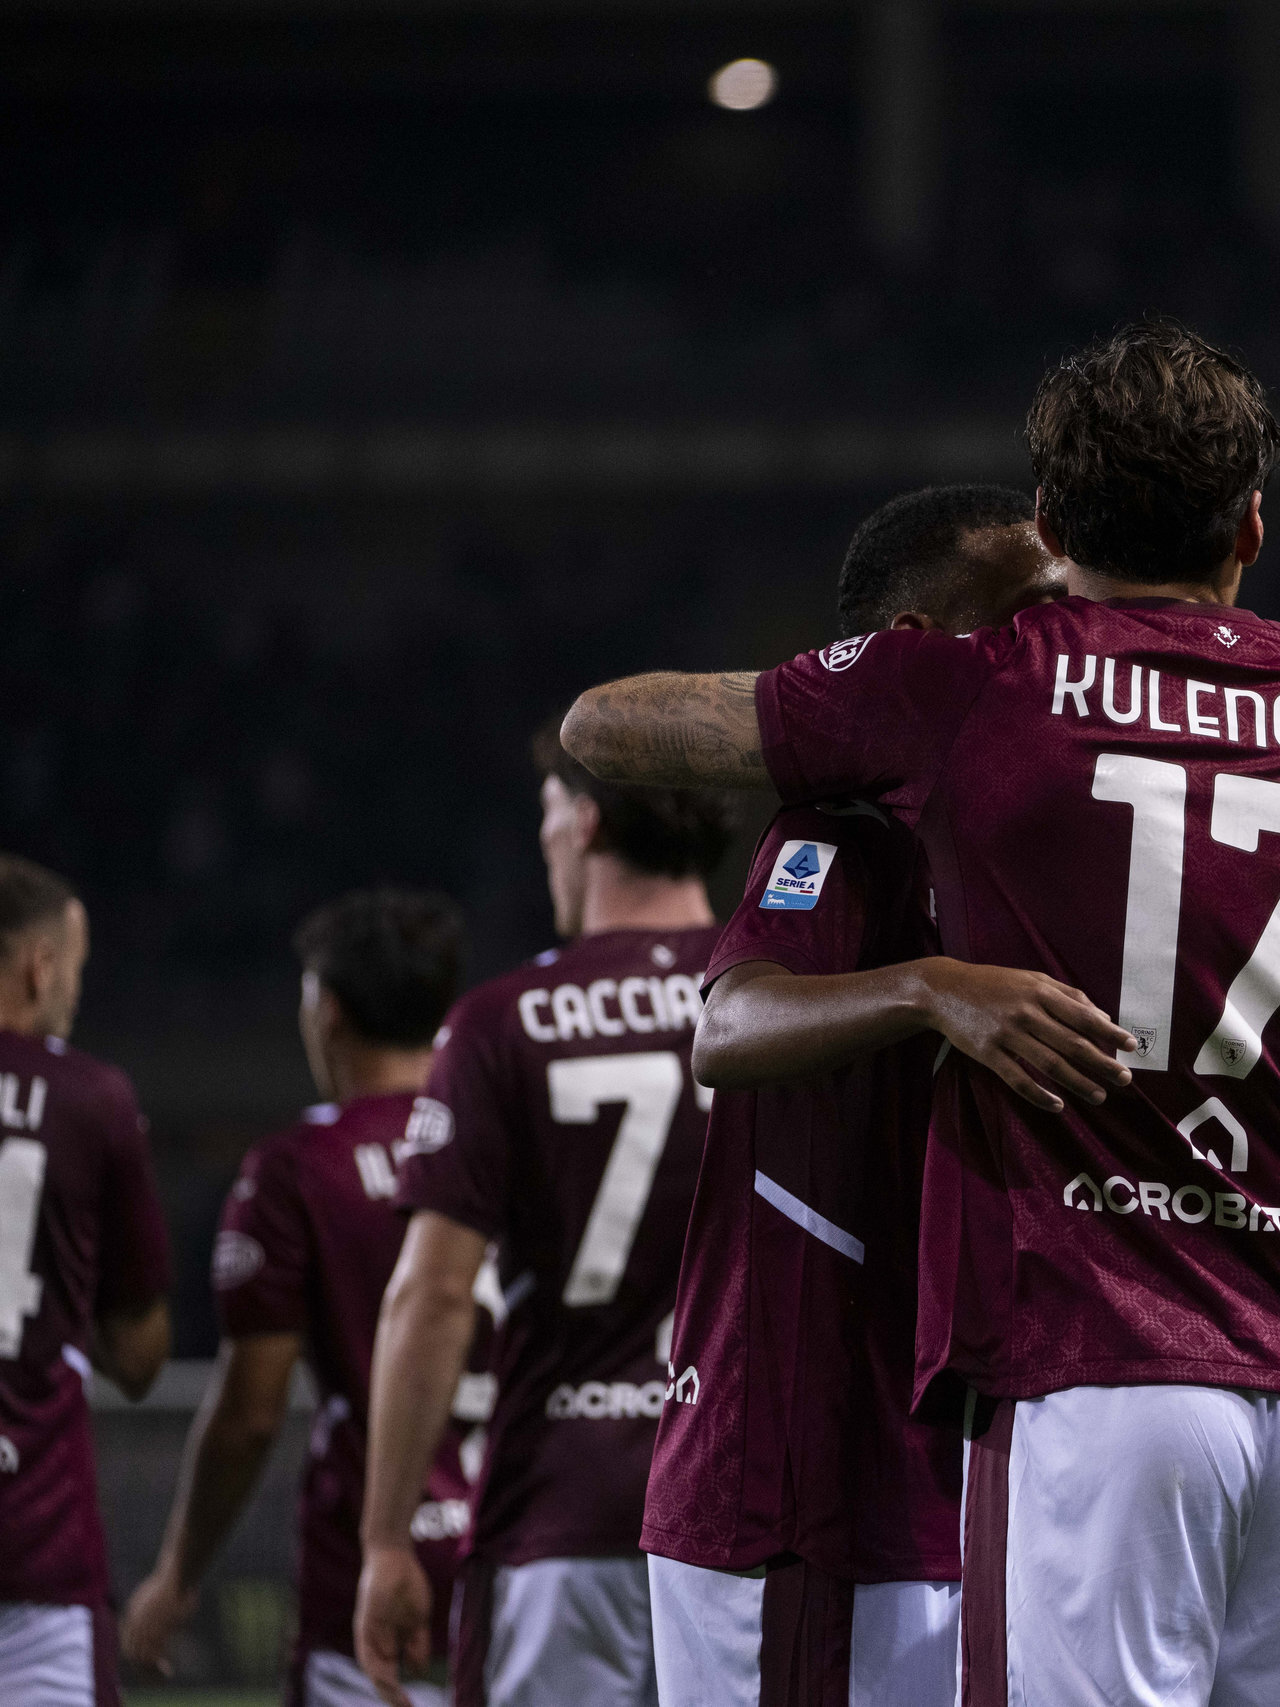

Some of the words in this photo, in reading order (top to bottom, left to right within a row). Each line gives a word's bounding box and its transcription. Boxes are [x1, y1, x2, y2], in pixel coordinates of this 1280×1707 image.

[776, 878, 806, 889] SERIE
[0, 1073, 47, 1130] LI
[547, 1050, 713, 1306] 7
